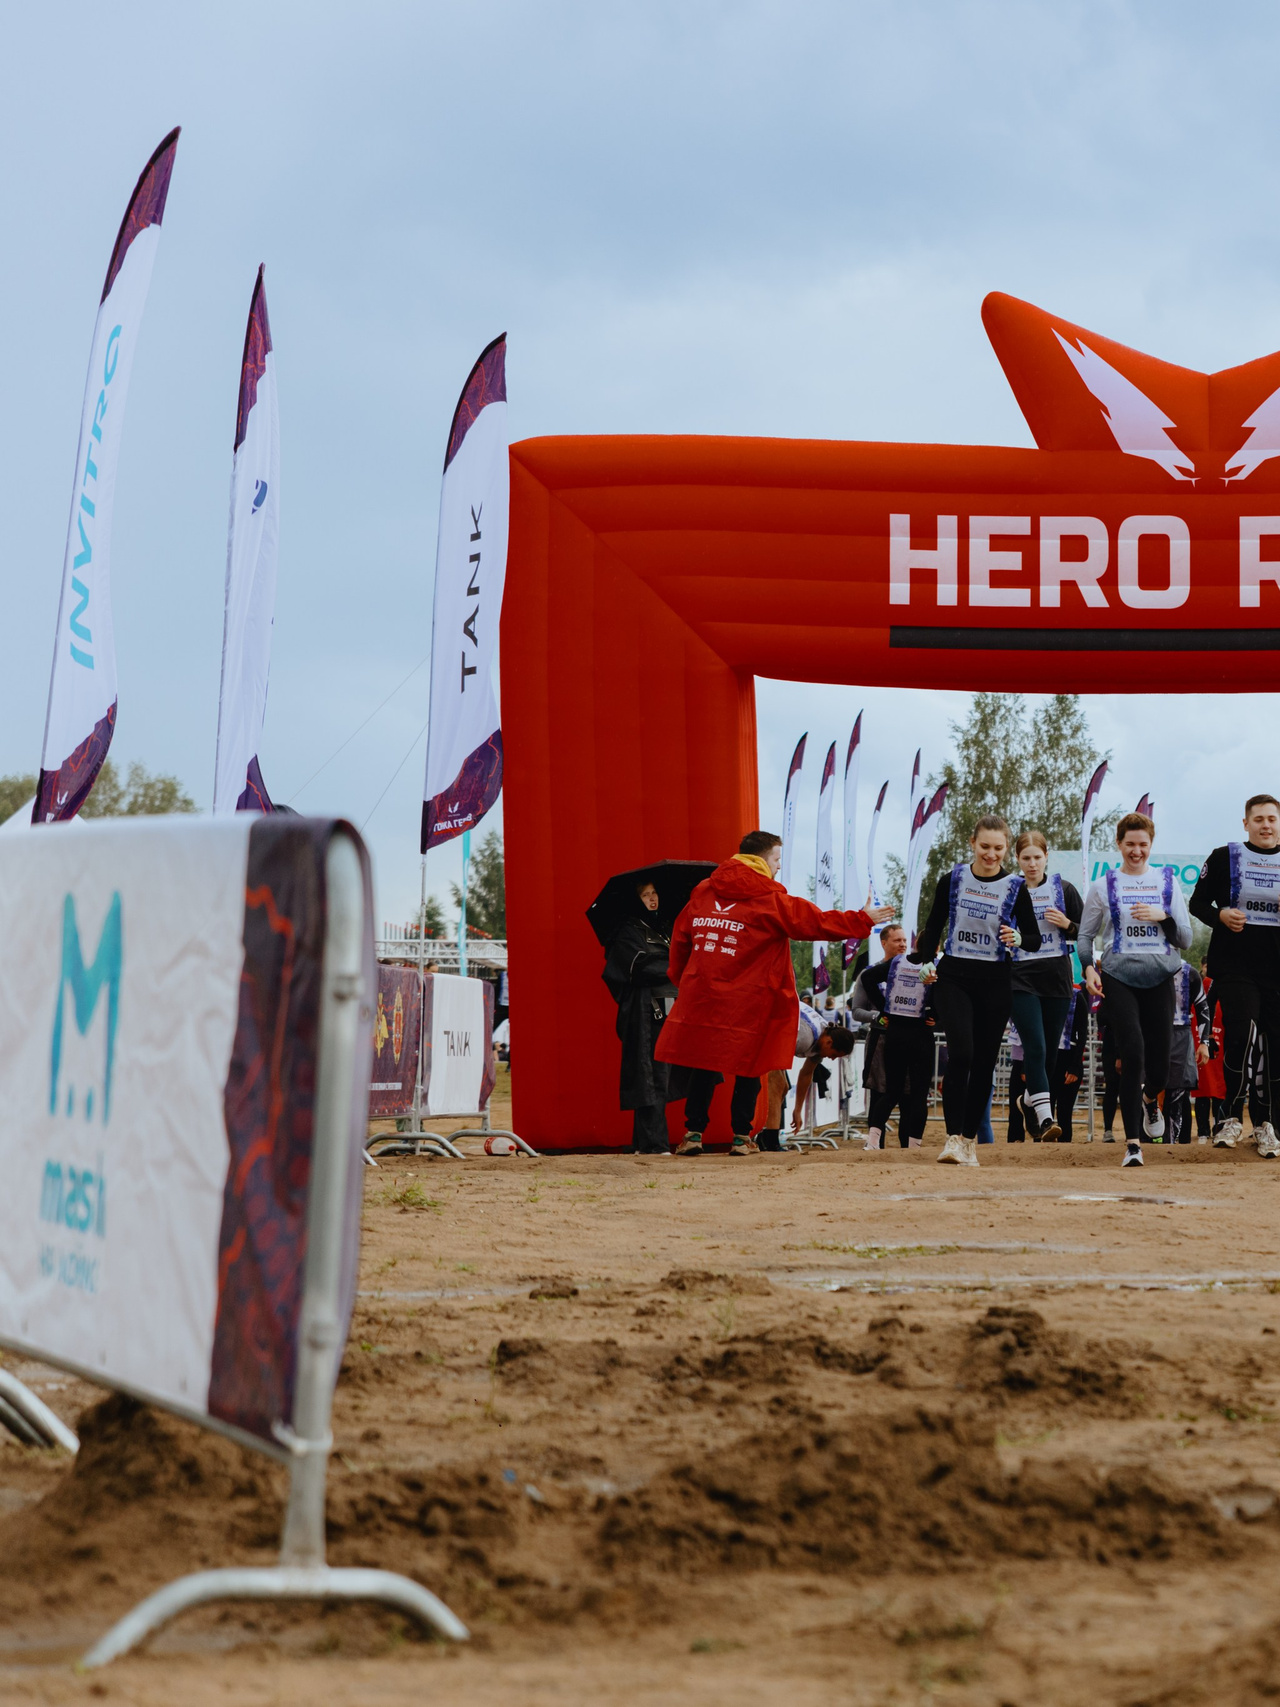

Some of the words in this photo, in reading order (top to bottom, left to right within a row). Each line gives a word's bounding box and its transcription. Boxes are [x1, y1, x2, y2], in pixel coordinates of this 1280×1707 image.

[889, 513, 1191, 609] HERO
[461, 501, 483, 693] TANK
[1246, 901, 1279, 913] 08503
[692, 917, 745, 932] ВОЛОНТЕР
[1126, 926, 1158, 937] 08509
[958, 930, 991, 945] 08510
[443, 1030, 471, 1057] TANK
